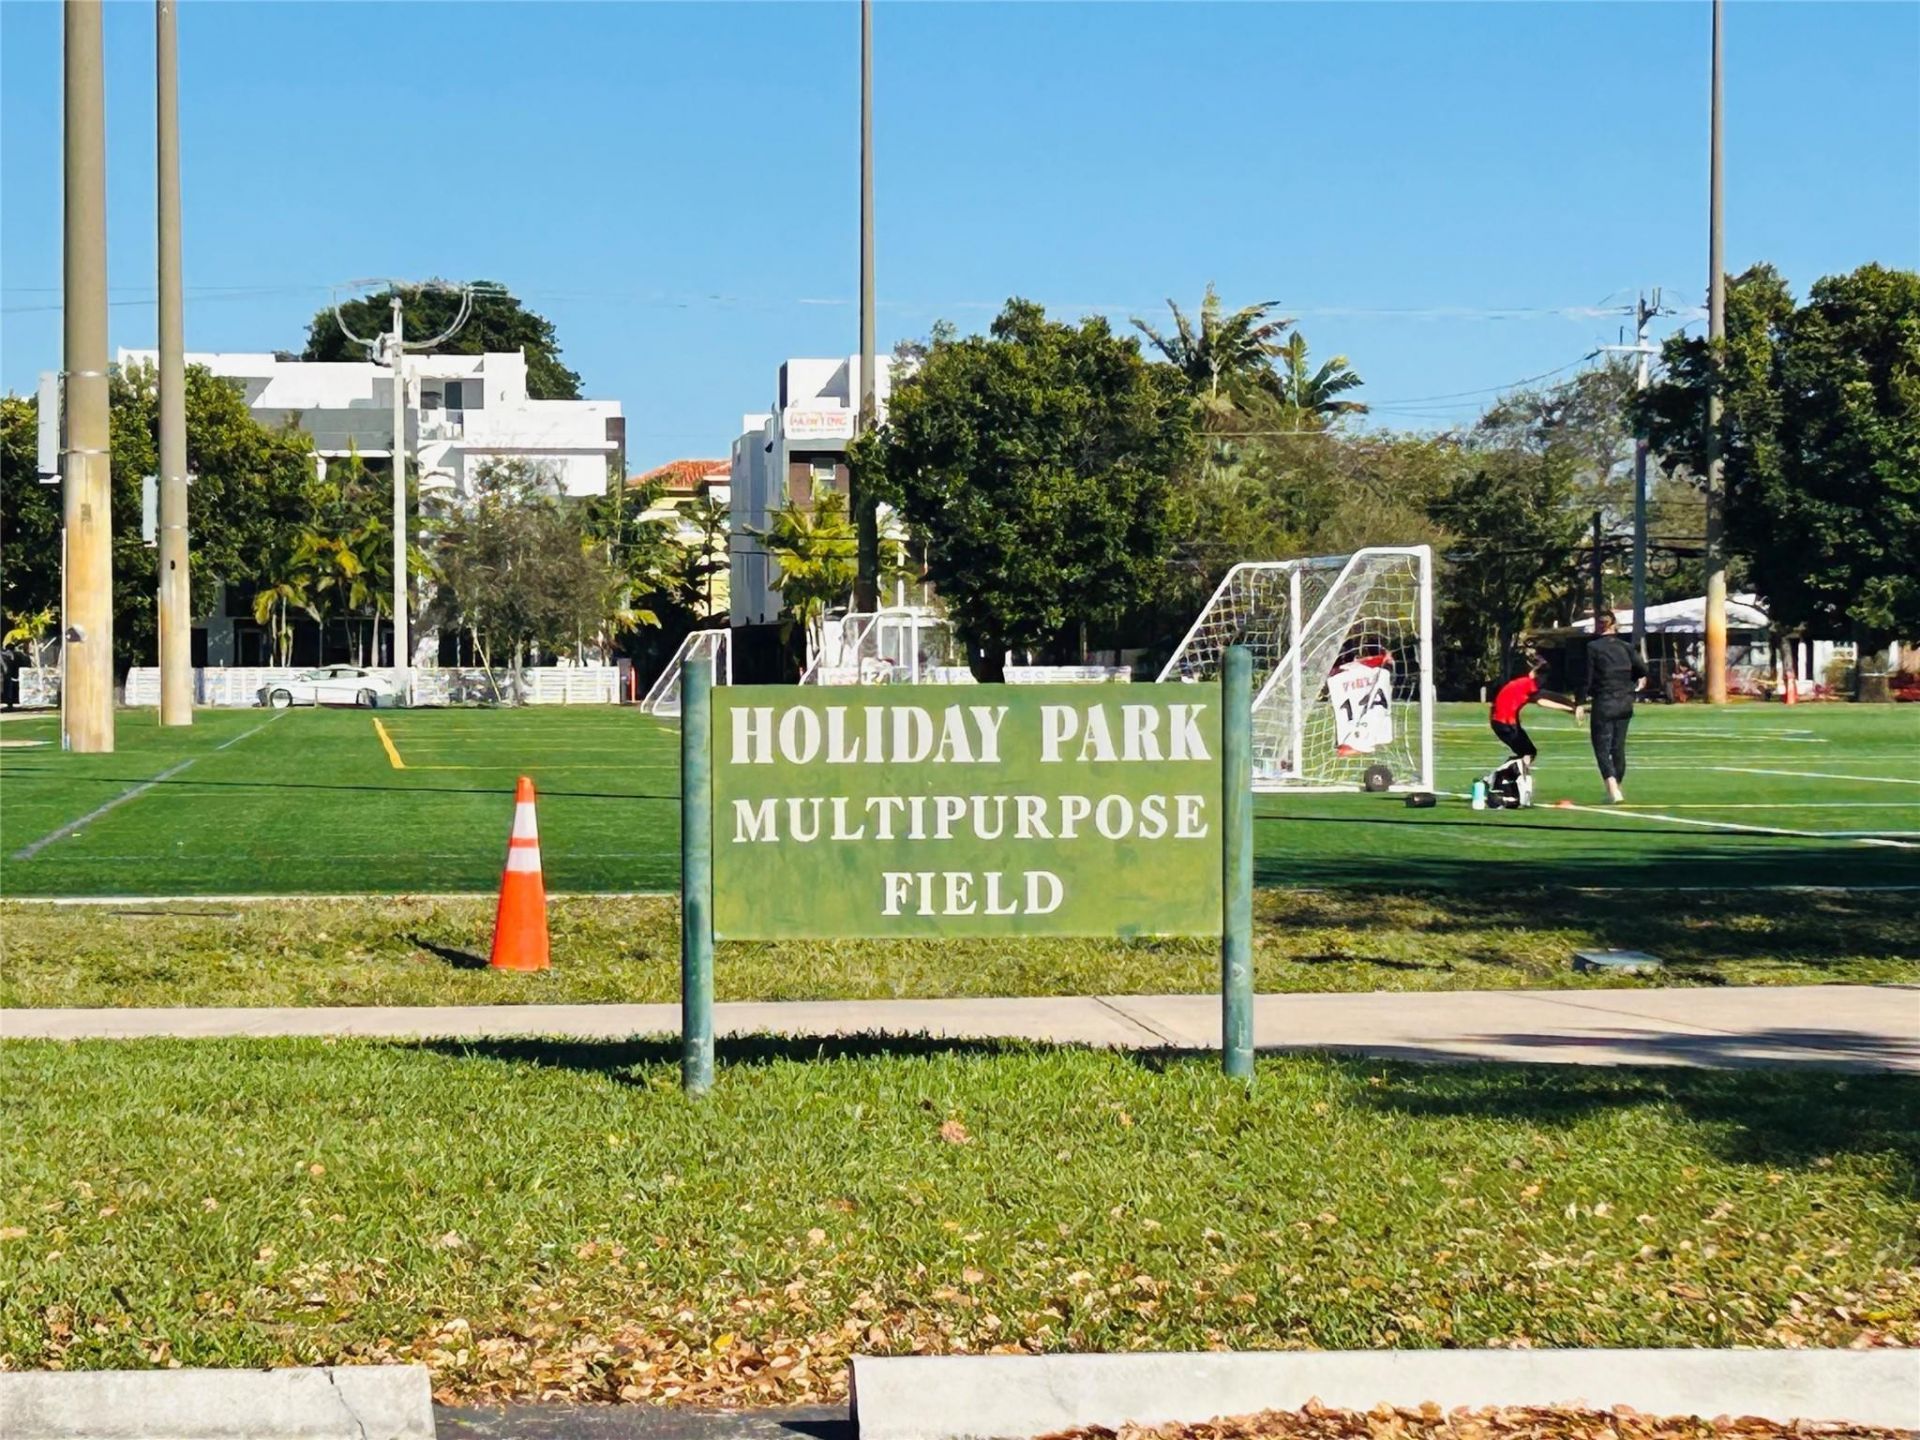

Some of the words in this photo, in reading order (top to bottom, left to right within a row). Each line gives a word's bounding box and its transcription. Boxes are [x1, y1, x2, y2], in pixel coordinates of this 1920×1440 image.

[730, 704, 1009, 764] HOLIDAY
[1041, 703, 1212, 763] PARK
[732, 794, 1208, 843] MULTIPURPOSE
[881, 870, 1064, 916] FIELD
